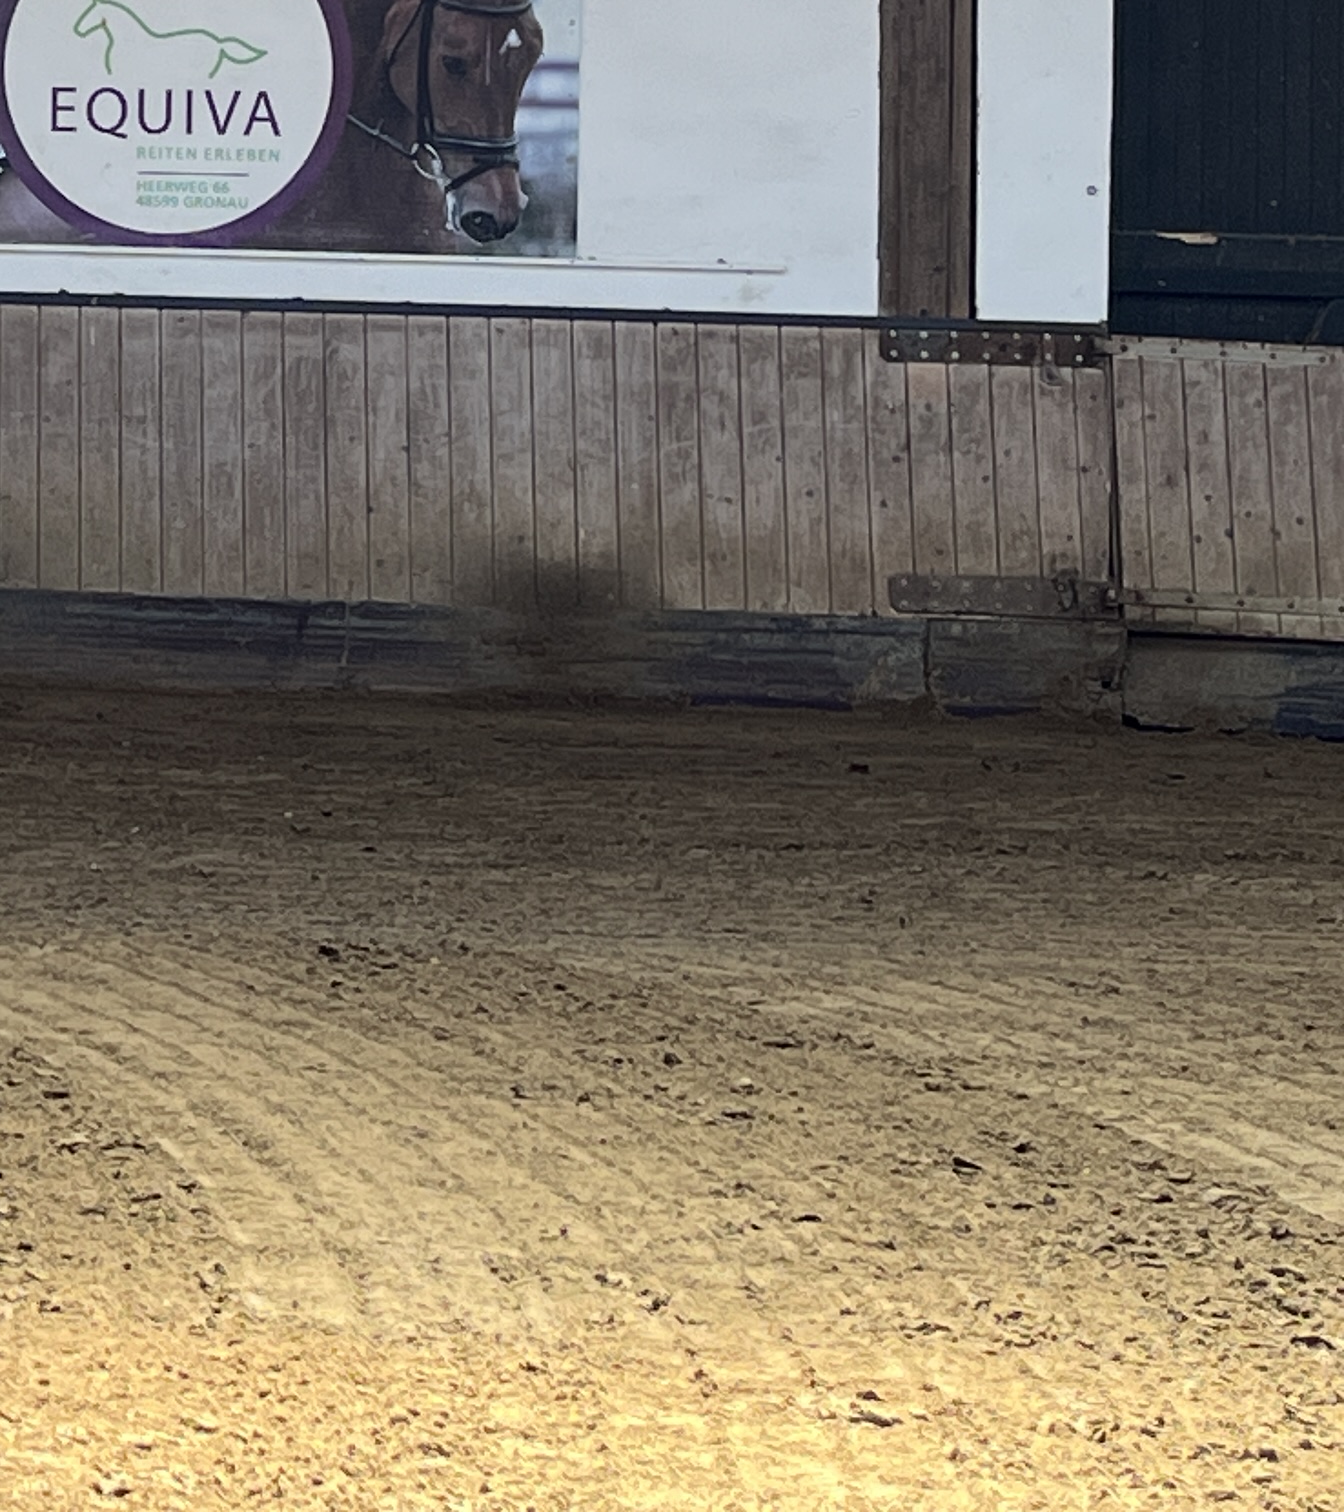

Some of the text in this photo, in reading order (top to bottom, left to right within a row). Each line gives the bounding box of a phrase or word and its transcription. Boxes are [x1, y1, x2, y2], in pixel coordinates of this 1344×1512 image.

[50, 86, 282, 140] EQUIVA
[136, 145, 281, 163] REITEN ERLEBEN
[136, 179, 209, 194] HEERWEG
[135, 195, 250, 210] 48599 GRONAU
